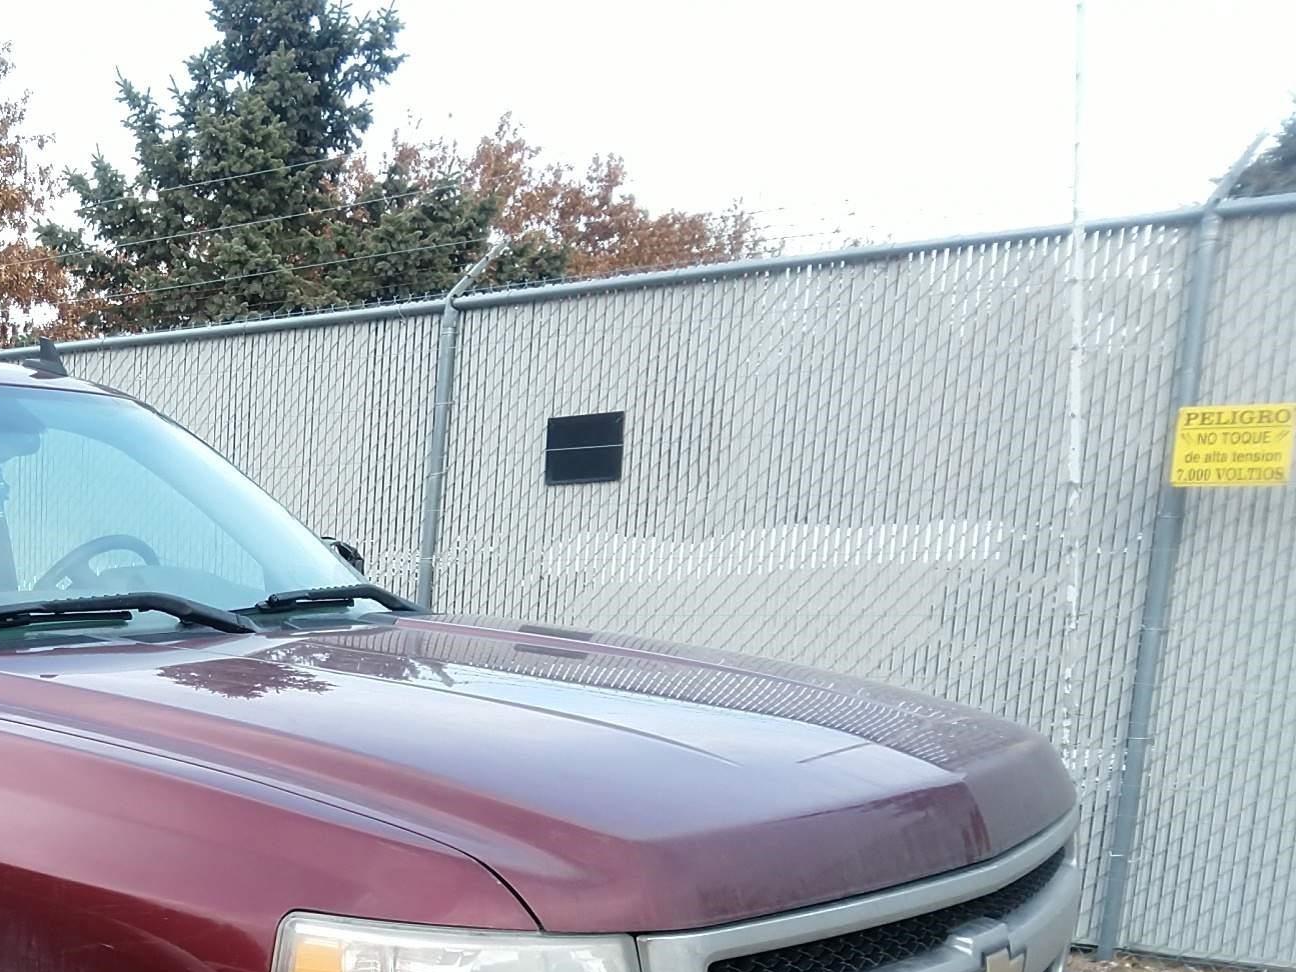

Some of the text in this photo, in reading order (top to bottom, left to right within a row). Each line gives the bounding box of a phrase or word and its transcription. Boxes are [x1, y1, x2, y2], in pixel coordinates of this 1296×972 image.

[1183, 408, 1292, 427] PELIGRO
[1197, 430, 1273, 446] NO TOQUE
[1184, 451, 1201, 464] de
[1204, 450, 1228, 464] alta
[1215, 466, 1286, 482] VOLTIOS
